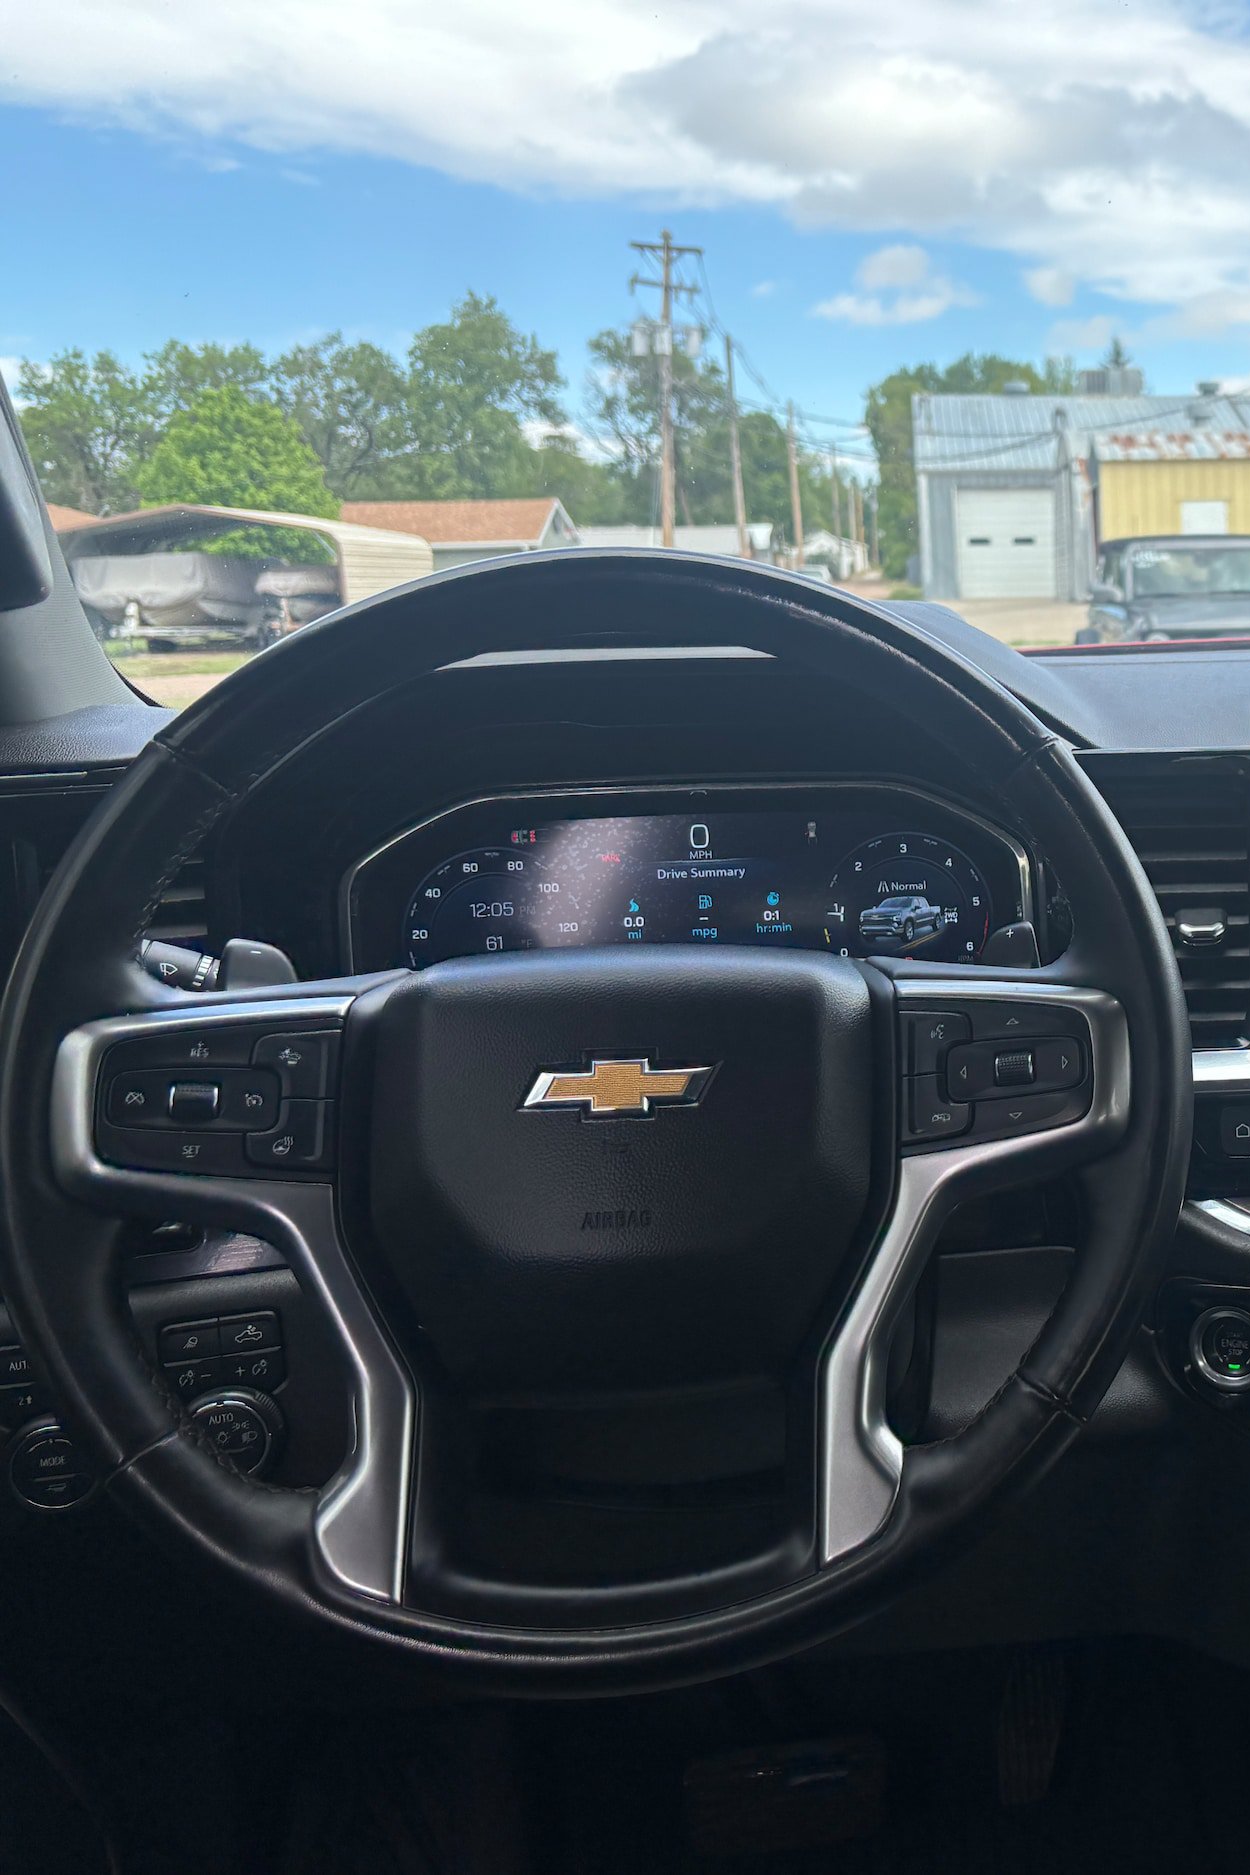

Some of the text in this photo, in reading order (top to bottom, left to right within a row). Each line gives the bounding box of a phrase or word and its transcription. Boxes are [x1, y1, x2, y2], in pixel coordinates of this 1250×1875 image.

[690, 824, 710, 848] 0
[900, 843, 908, 853] 3
[690, 850, 713, 860] MPH
[462, 863, 478, 873] 60
[507, 860, 524, 871] 80
[854, 861, 862, 872] 2
[945, 858, 952, 868] 4
[657, 866, 746, 880] Drive Summary
[538, 883, 560, 893] 100
[892, 880, 927, 892] Normal
[425, 888, 441, 898] 40
[972, 896, 980, 906] 5
[470, 902, 514, 918] 12:05
[763, 910, 780, 922] 0:1
[559, 922, 578, 932] 120
[623, 916, 644, 928] 0.0
[692, 926, 718, 939] mpg
[756, 922, 792, 934] hr:min
[412, 930, 428, 940] 20
[628, 929, 642, 939] mi
[486, 936, 504, 950] 61
[966, 941, 974, 951] 6
[840, 948, 849, 958] 0
[182, 1145, 201, 1155] SET
[580, 1209, 652, 1230] AIRBAG
[9, 1360, 30, 1372] AUT
[209, 1413, 234, 1426] AUTO
